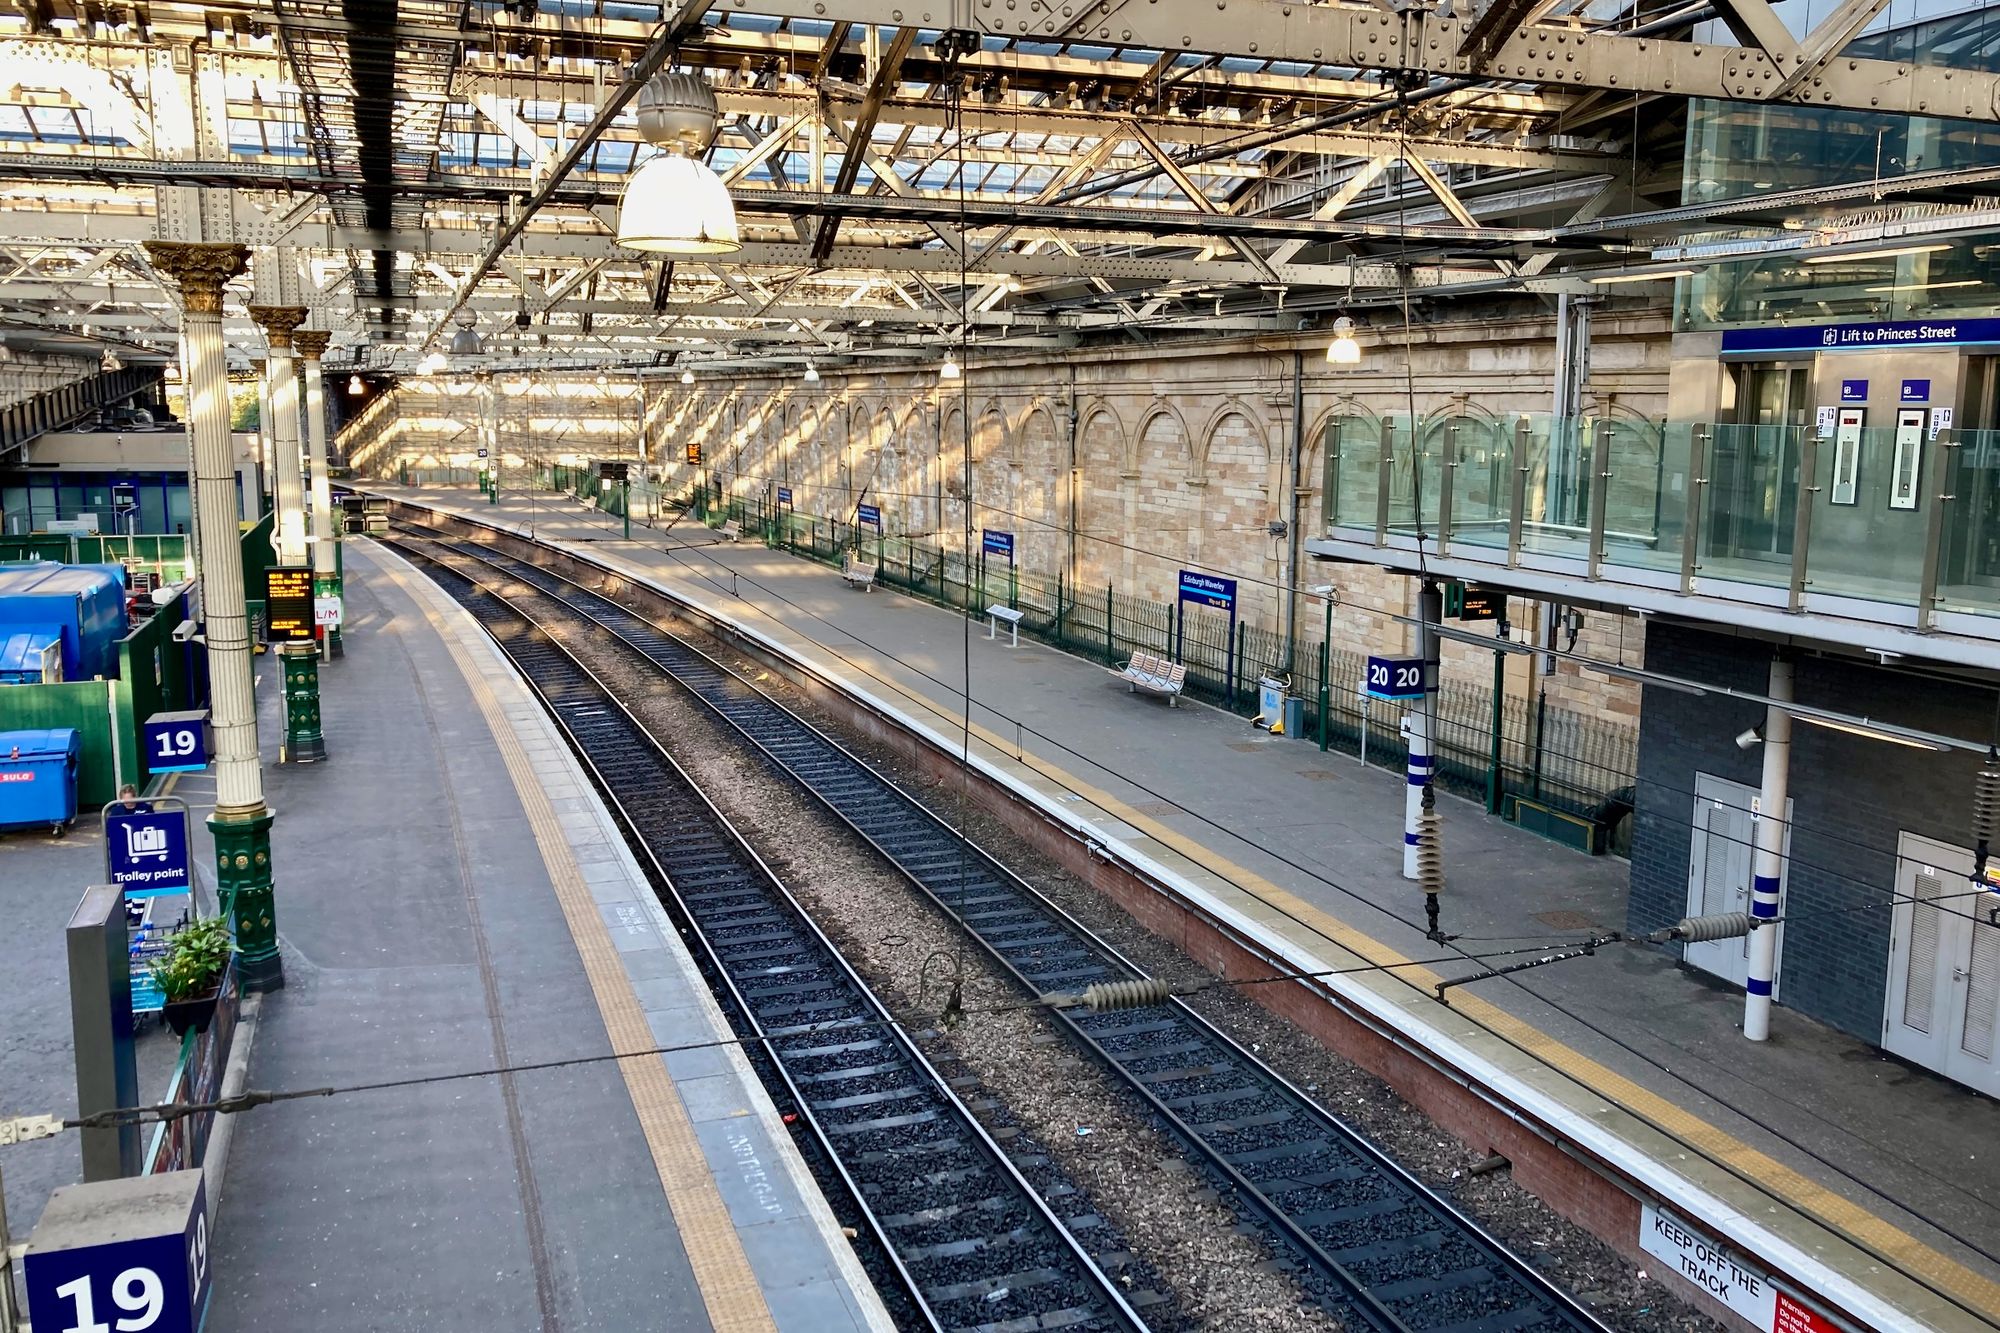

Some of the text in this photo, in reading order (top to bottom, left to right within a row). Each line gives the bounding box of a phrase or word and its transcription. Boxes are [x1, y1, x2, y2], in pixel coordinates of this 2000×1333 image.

[1841, 326, 1957, 342] Lift to Princes Street
[1183, 574, 1225, 592] Edinburgh Waverley
[1370, 664, 1389, 687] 20
[1396, 667, 1420, 687] 20
[155, 730, 196, 757] 19
[114, 867, 184, 882] Trolley point
[190, 1212, 207, 1306] 19
[1655, 1216, 1760, 1298] KEEP OFF THE
[1679, 1254, 1730, 1301] TRACK
[56, 1267, 164, 1333] 19
[1781, 1297, 1810, 1323] Warning
[1779, 1318, 1789, 1328] on
[1780, 1308, 1790, 1320] Do
[1790, 1316, 1803, 1329] not
